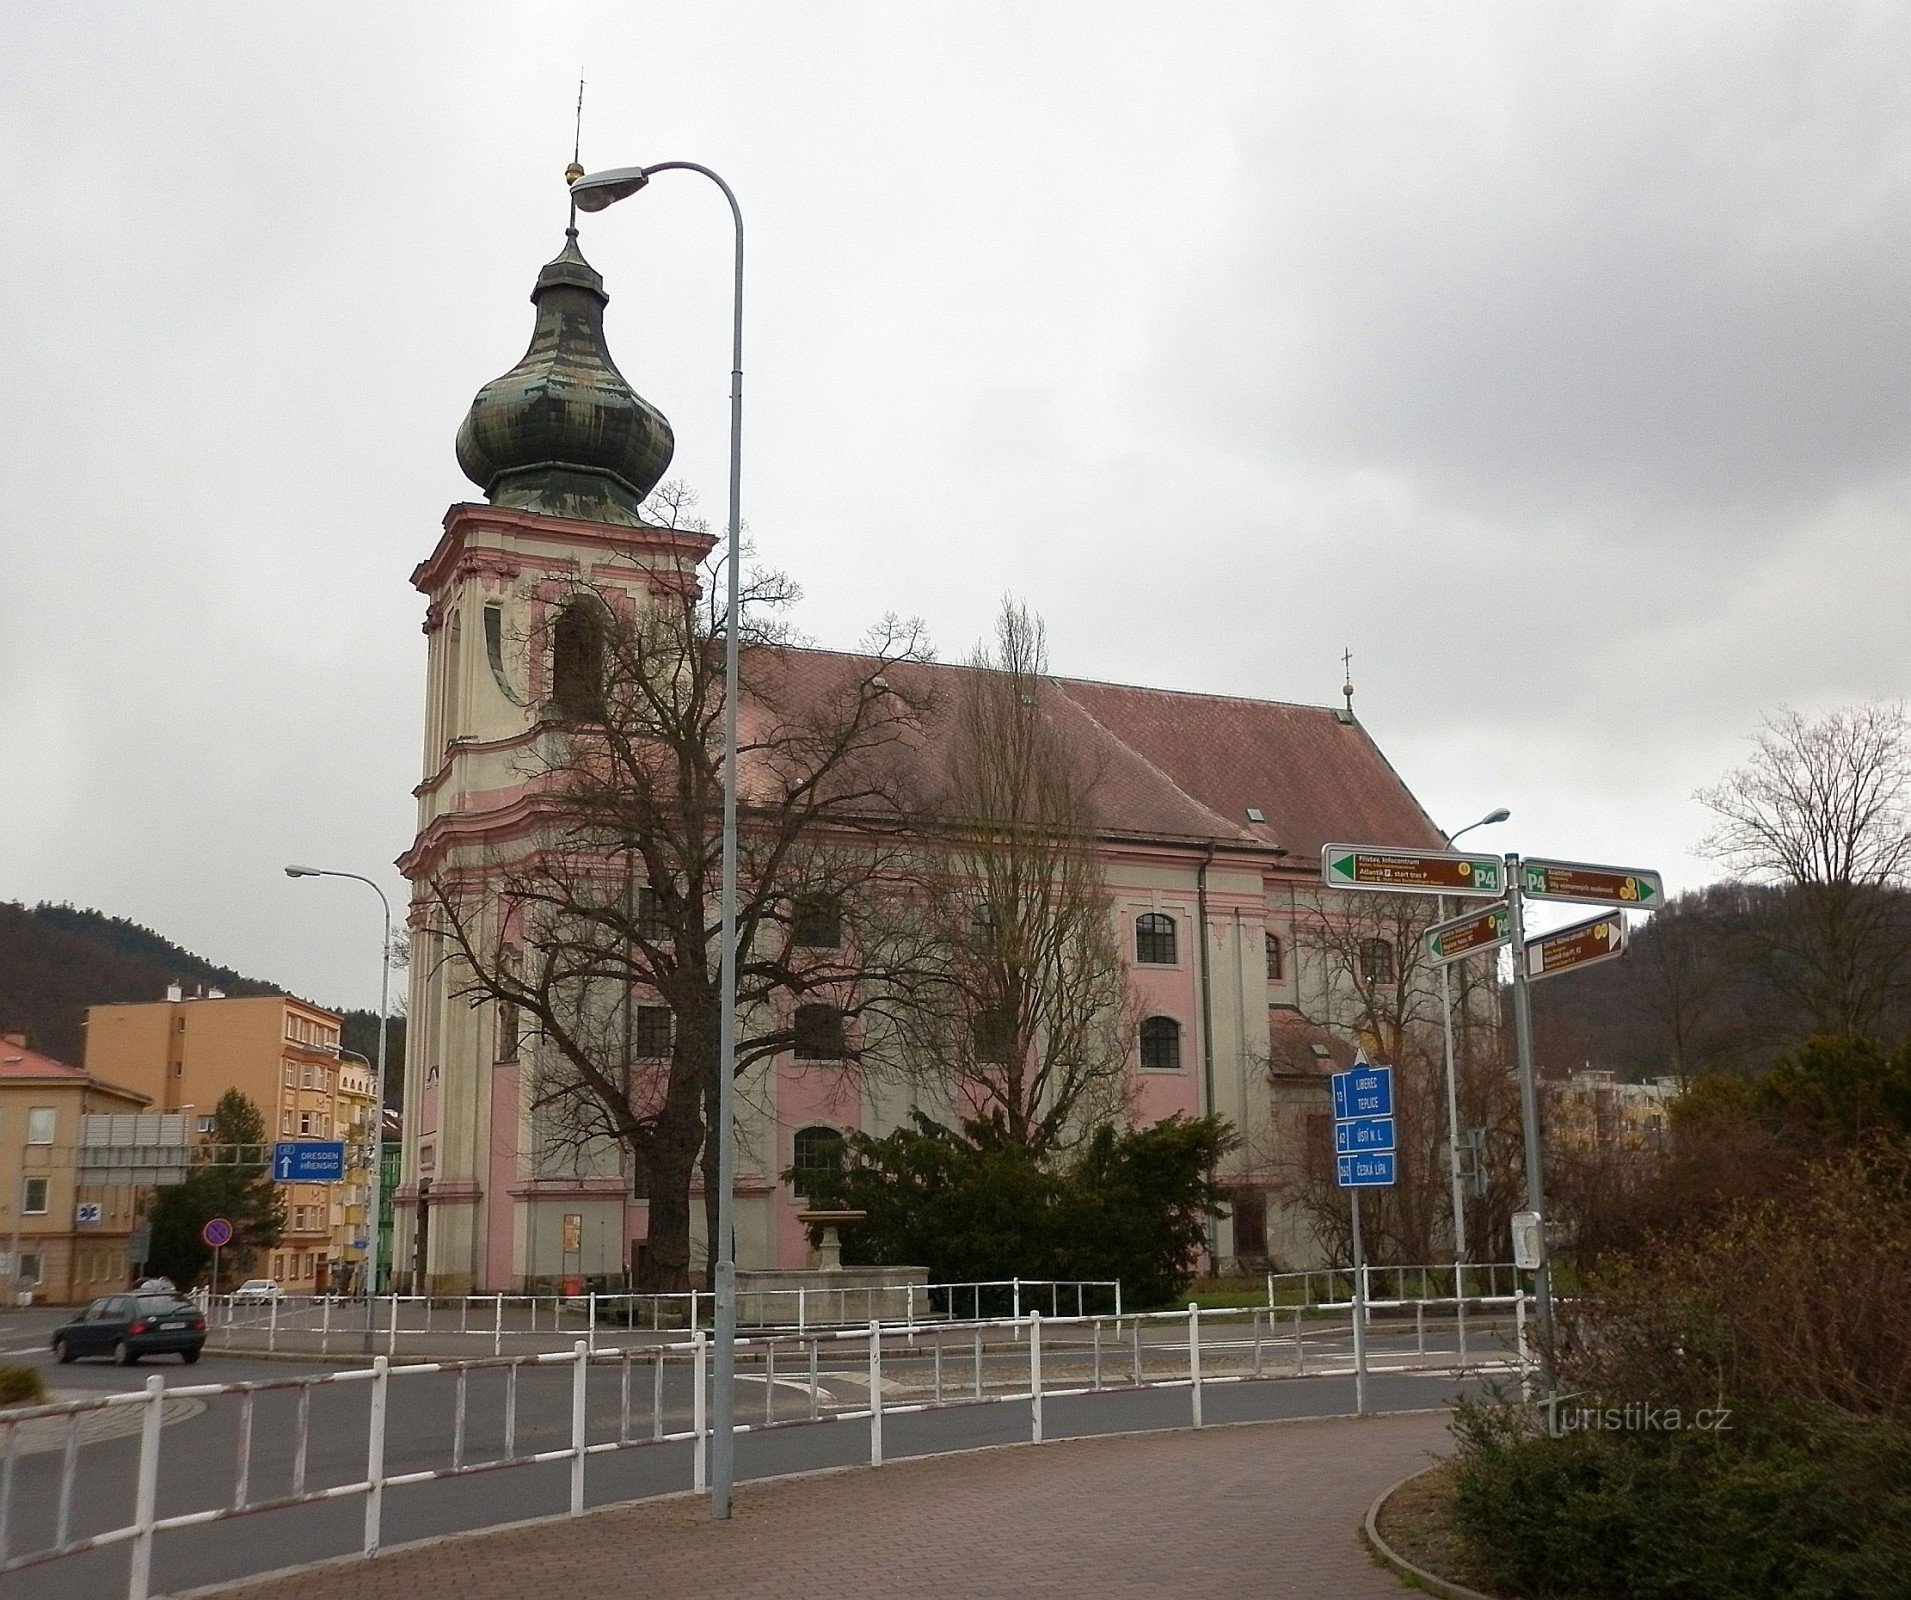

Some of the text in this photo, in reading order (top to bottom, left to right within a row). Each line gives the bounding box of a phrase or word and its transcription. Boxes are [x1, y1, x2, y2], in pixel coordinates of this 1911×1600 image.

[1382, 857, 1420, 865] Infocentrum
[1474, 869, 1496, 888] P4
[1528, 874, 1546, 892] P4
[1356, 1077, 1377, 1090] LIBEREC
[1336, 1092, 1343, 1102] 13
[1358, 1096, 1378, 1109] TEPLICE
[1339, 1132, 1346, 1144] 62
[1358, 1128, 1369, 1142] ÚSTÍ
[300, 1160, 338, 1169] HŘENSKO
[1357, 1160, 1386, 1176] ČESKÁ LÍPA
